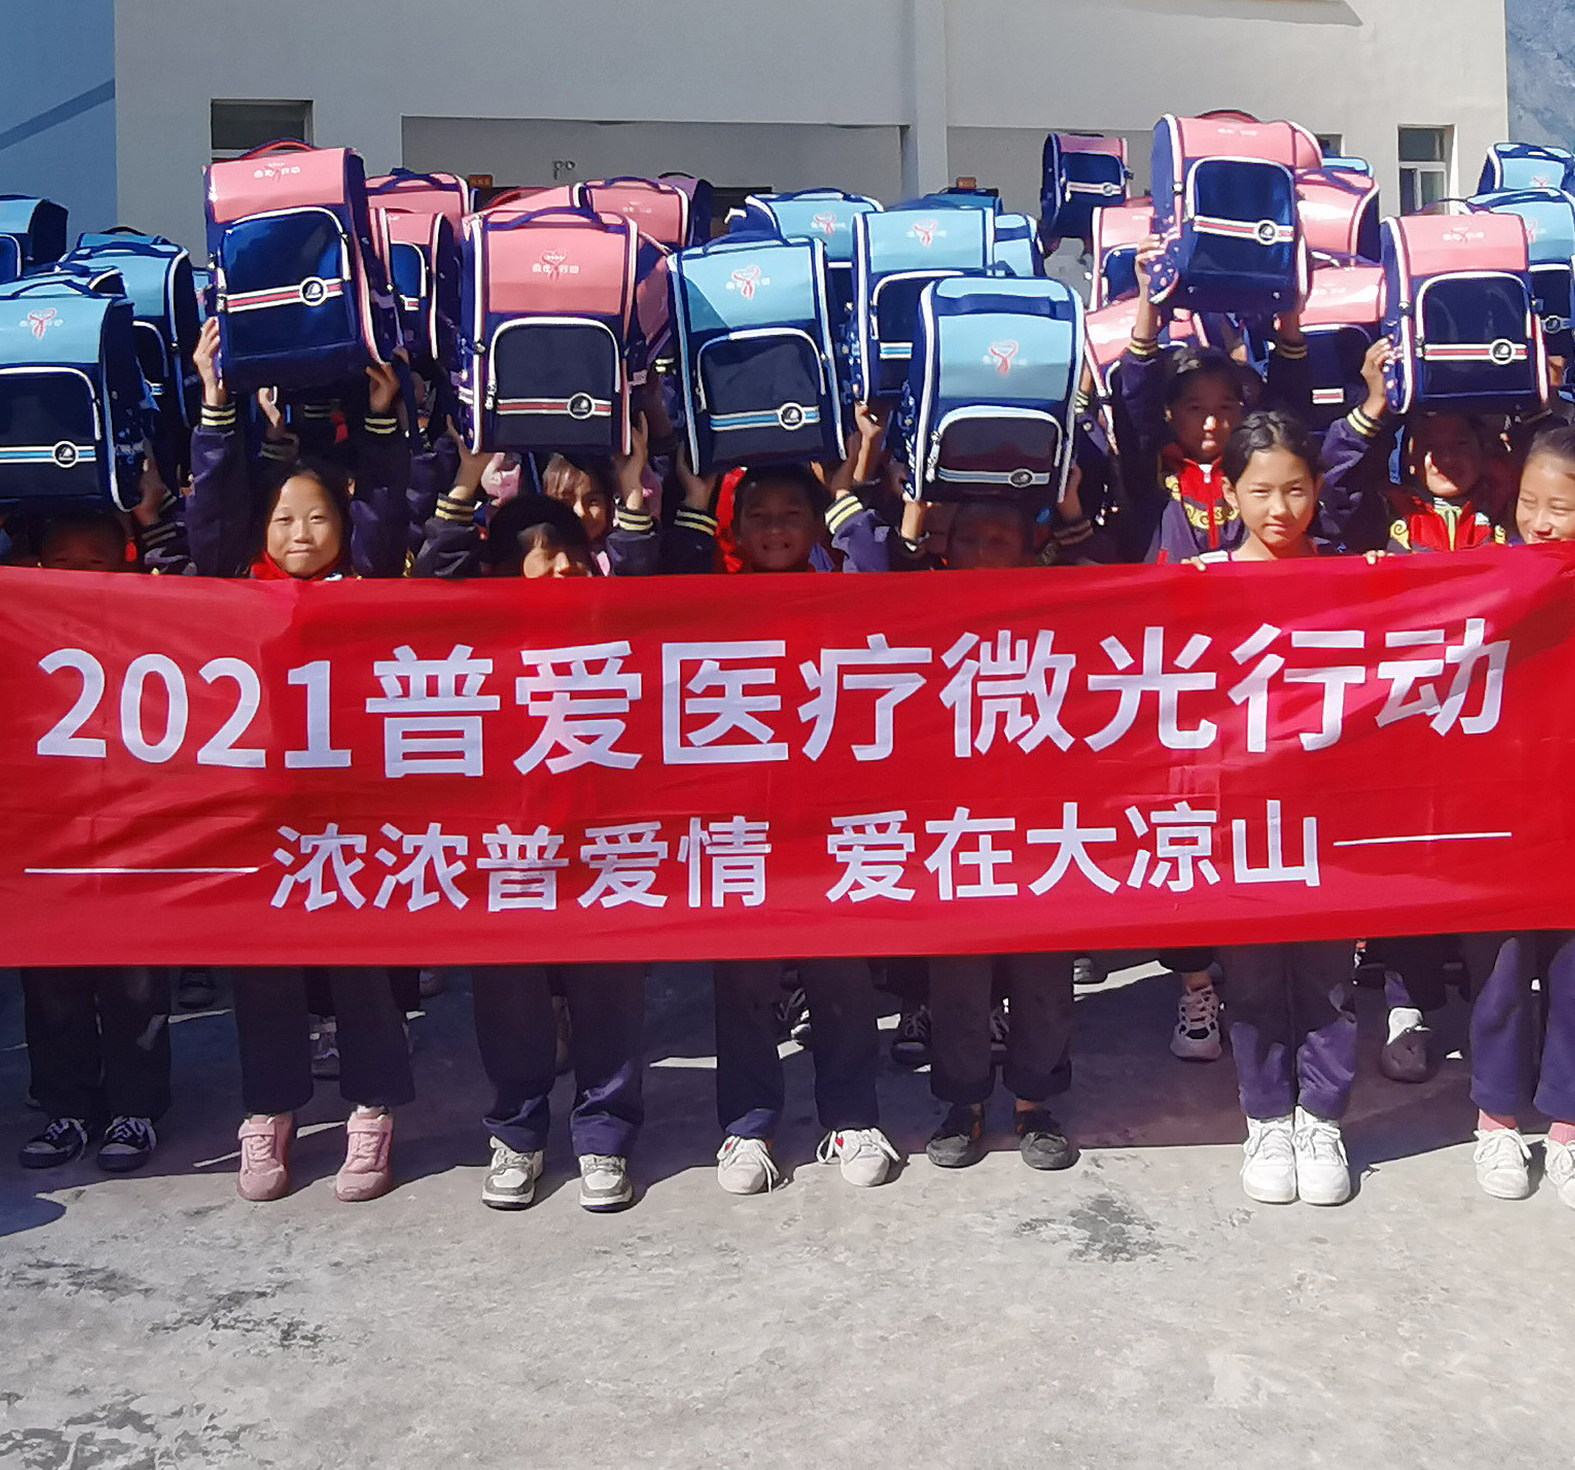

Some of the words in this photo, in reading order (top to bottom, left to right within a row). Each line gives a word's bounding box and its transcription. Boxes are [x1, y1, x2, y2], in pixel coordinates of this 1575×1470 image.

[36, 617, 1510, 779] 2021普爱医疗微光行动
[270, 815, 772, 913] 浓浓普爱情
[825, 799, 1321, 904] 爱在大凉山
